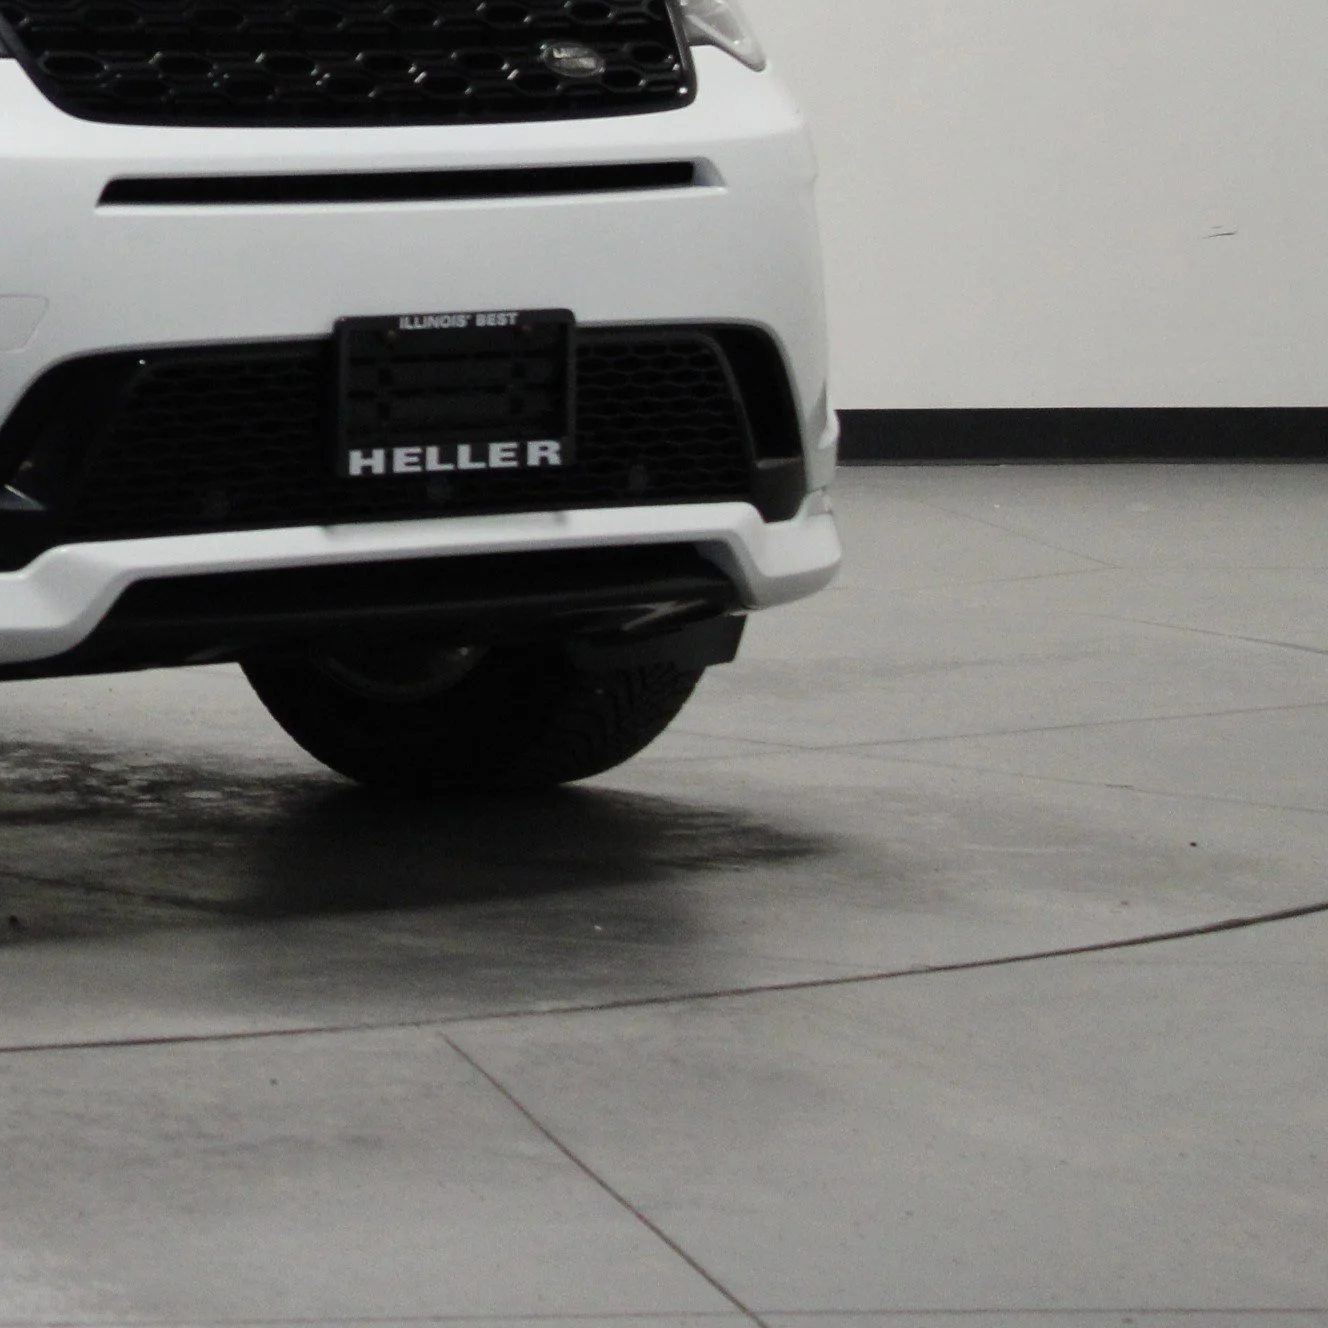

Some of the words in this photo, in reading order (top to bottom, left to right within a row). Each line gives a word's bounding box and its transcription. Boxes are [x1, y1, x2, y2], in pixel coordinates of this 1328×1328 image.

[399, 313, 471, 330] ILLINOIS'
[476, 312, 519, 326] BEST
[348, 439, 562, 476] HELLER
